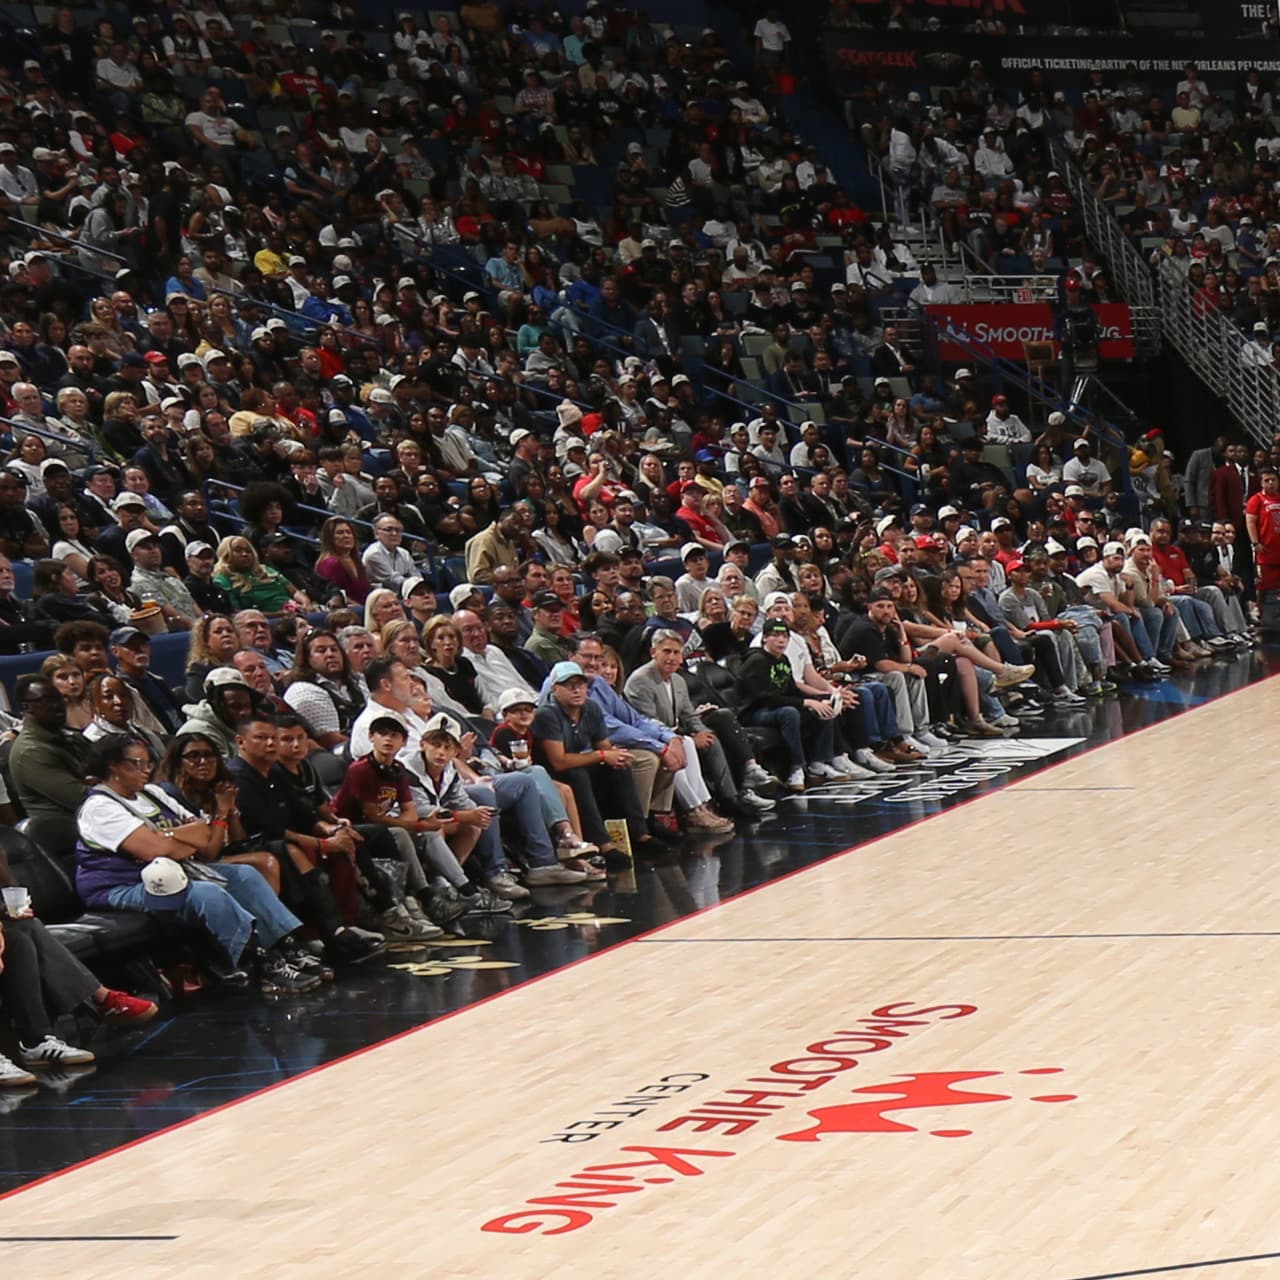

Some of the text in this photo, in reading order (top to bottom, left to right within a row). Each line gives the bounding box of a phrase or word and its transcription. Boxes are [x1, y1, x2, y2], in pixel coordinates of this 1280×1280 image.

[1240, 4, 1264, 18] THE
[1001, 57, 1043, 69] OFFICIAL
[974, 322, 1054, 343] SMOOTH
[656, 1001, 979, 1136] SMOOTHIE
[538, 1072, 710, 1145] CENTER
